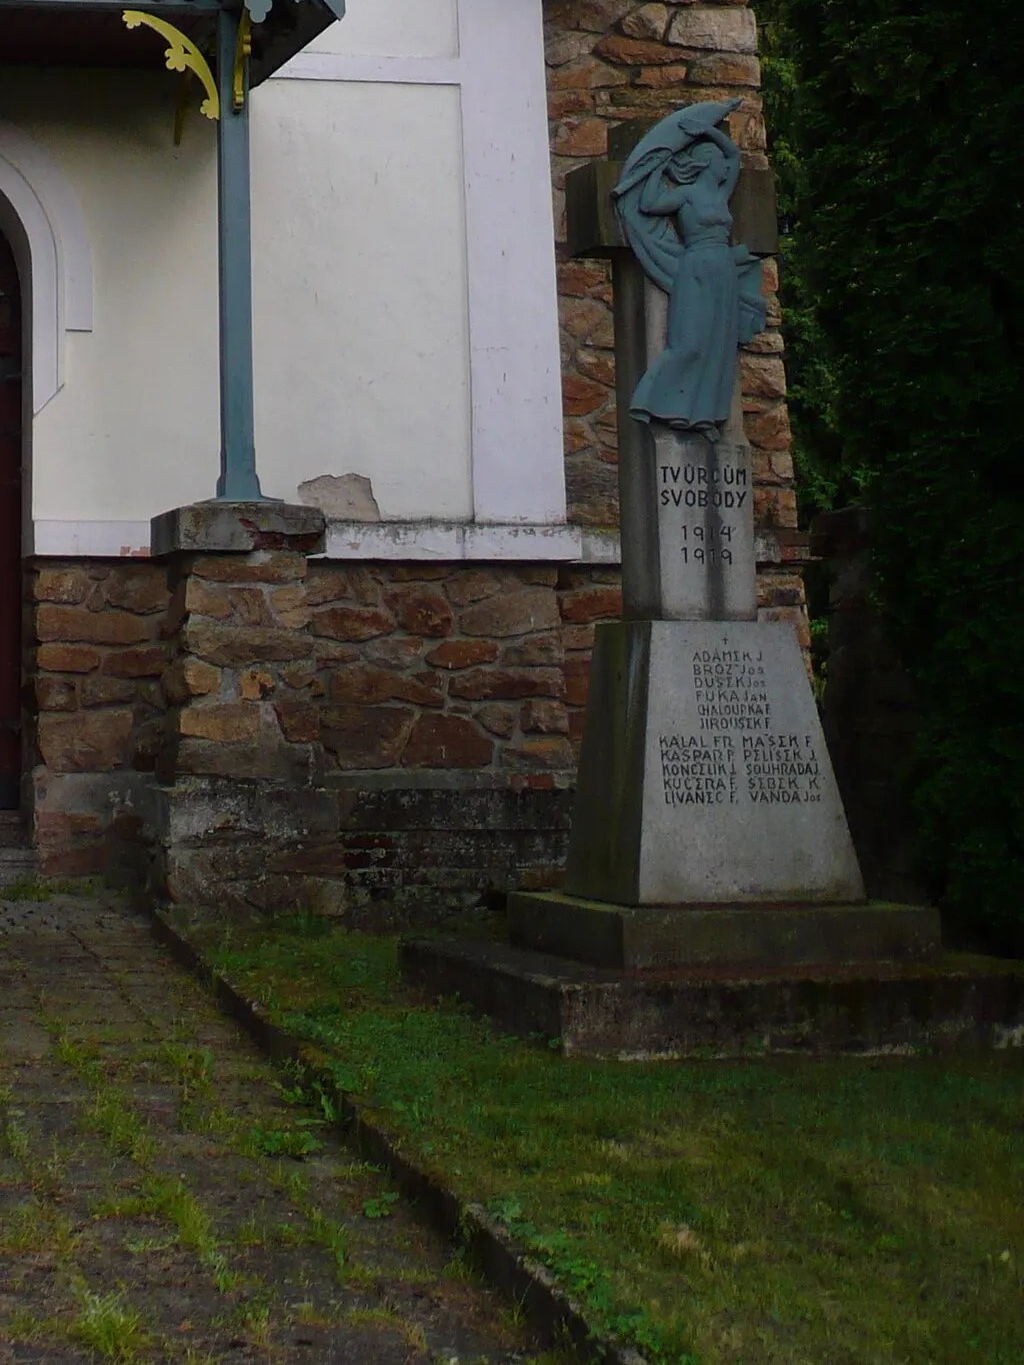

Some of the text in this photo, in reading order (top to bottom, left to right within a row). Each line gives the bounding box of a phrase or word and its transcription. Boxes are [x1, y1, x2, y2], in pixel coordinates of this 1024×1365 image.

[660, 489, 747, 508] SVOBODY
[681, 525, 732, 542] 1914
[681, 547, 733, 565] 1919
[696, 689, 740, 702] FUKA
[748, 790, 801, 803] VANDA
